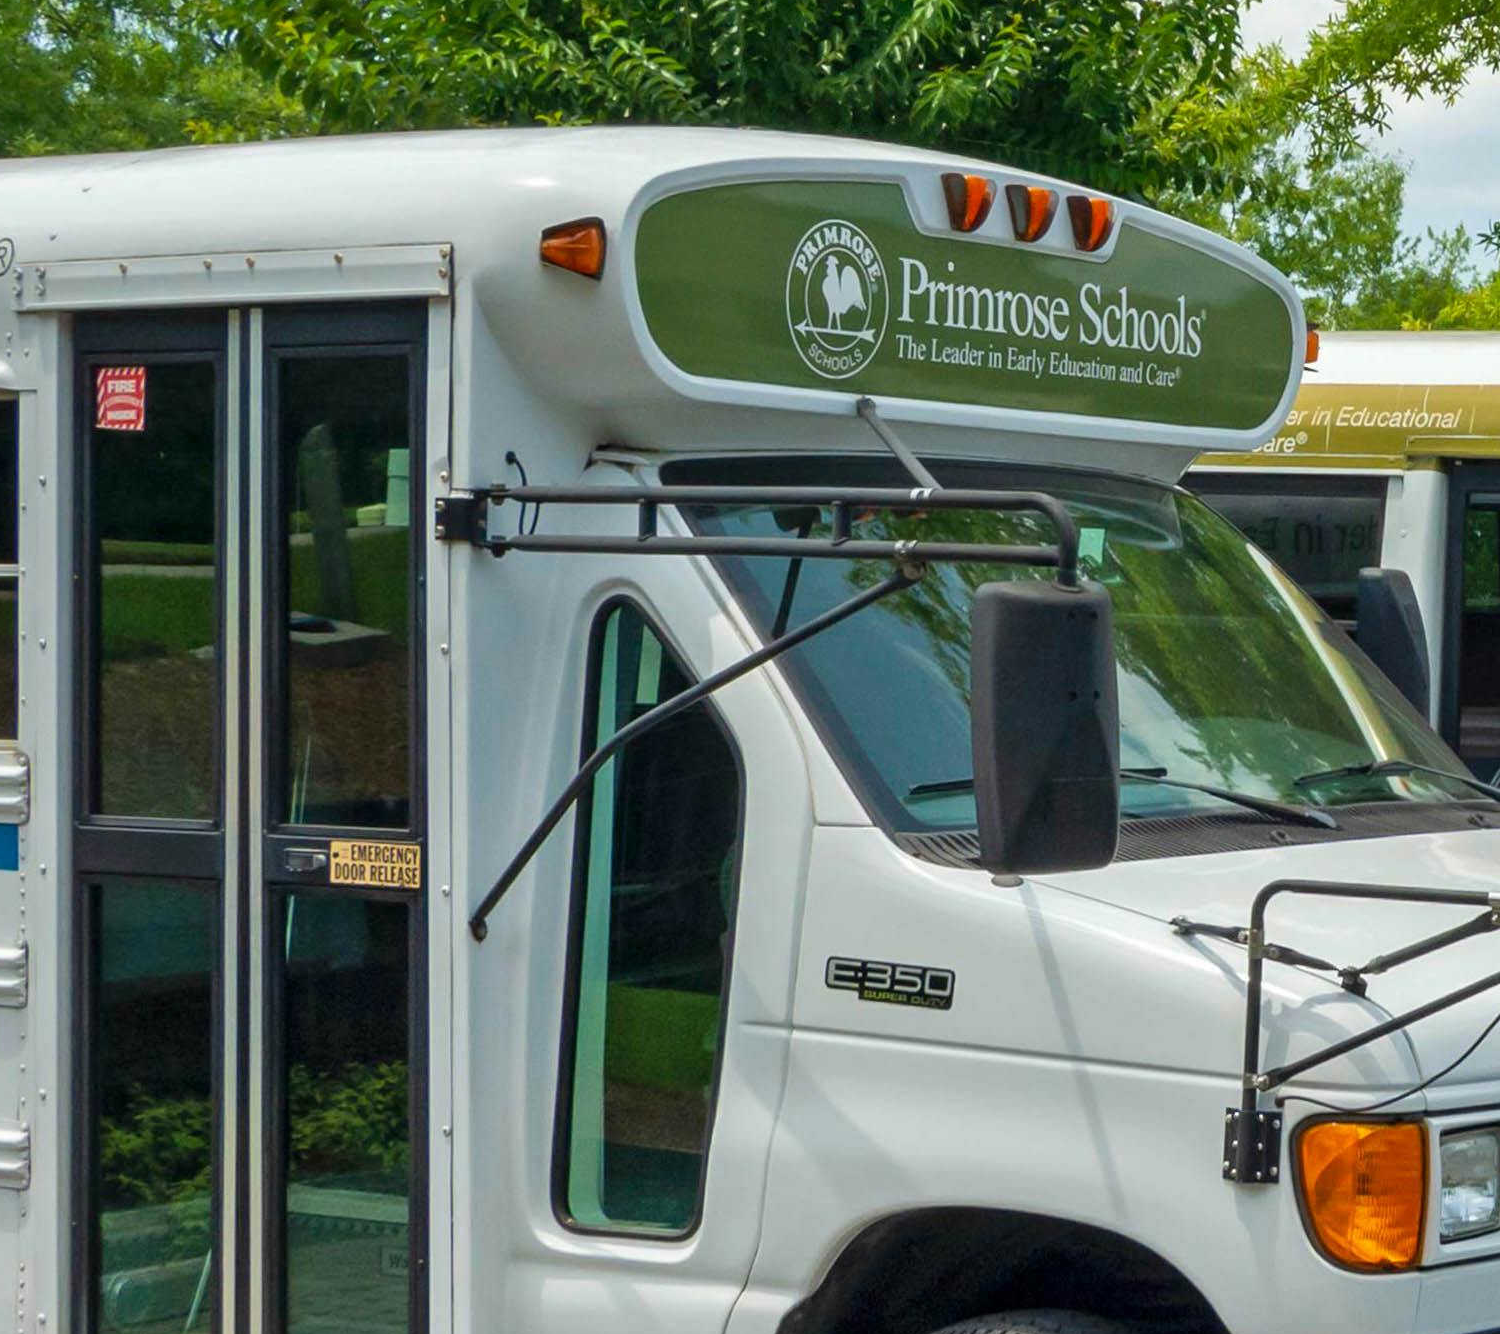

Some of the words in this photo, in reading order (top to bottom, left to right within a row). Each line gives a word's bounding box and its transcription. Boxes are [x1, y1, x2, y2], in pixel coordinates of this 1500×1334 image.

[796, 226, 881, 282] PRIMROSE
[897, 257, 1070, 341] Primrose
[808, 343, 863, 371] SCHOOLS
[896, 334, 927, 360] The
[931, 338, 985, 367] Leader
[988, 344, 1003, 370] in
[1007, 347, 1046, 378] Early
[1049, 352, 1117, 382] Education
[1119, 362, 1143, 384] and
[107, 380, 136, 394] FIRE
[1311, 406, 1331, 426] in
[1336, 406, 1463, 428] Educational
[350, 844, 418, 866] EMERGENCY
[334, 862, 367, 881] DOOR
[369, 864, 418, 885] RELEASE
[864, 990, 908, 1002] SUPER
[911, 995, 947, 1007] DUTY
